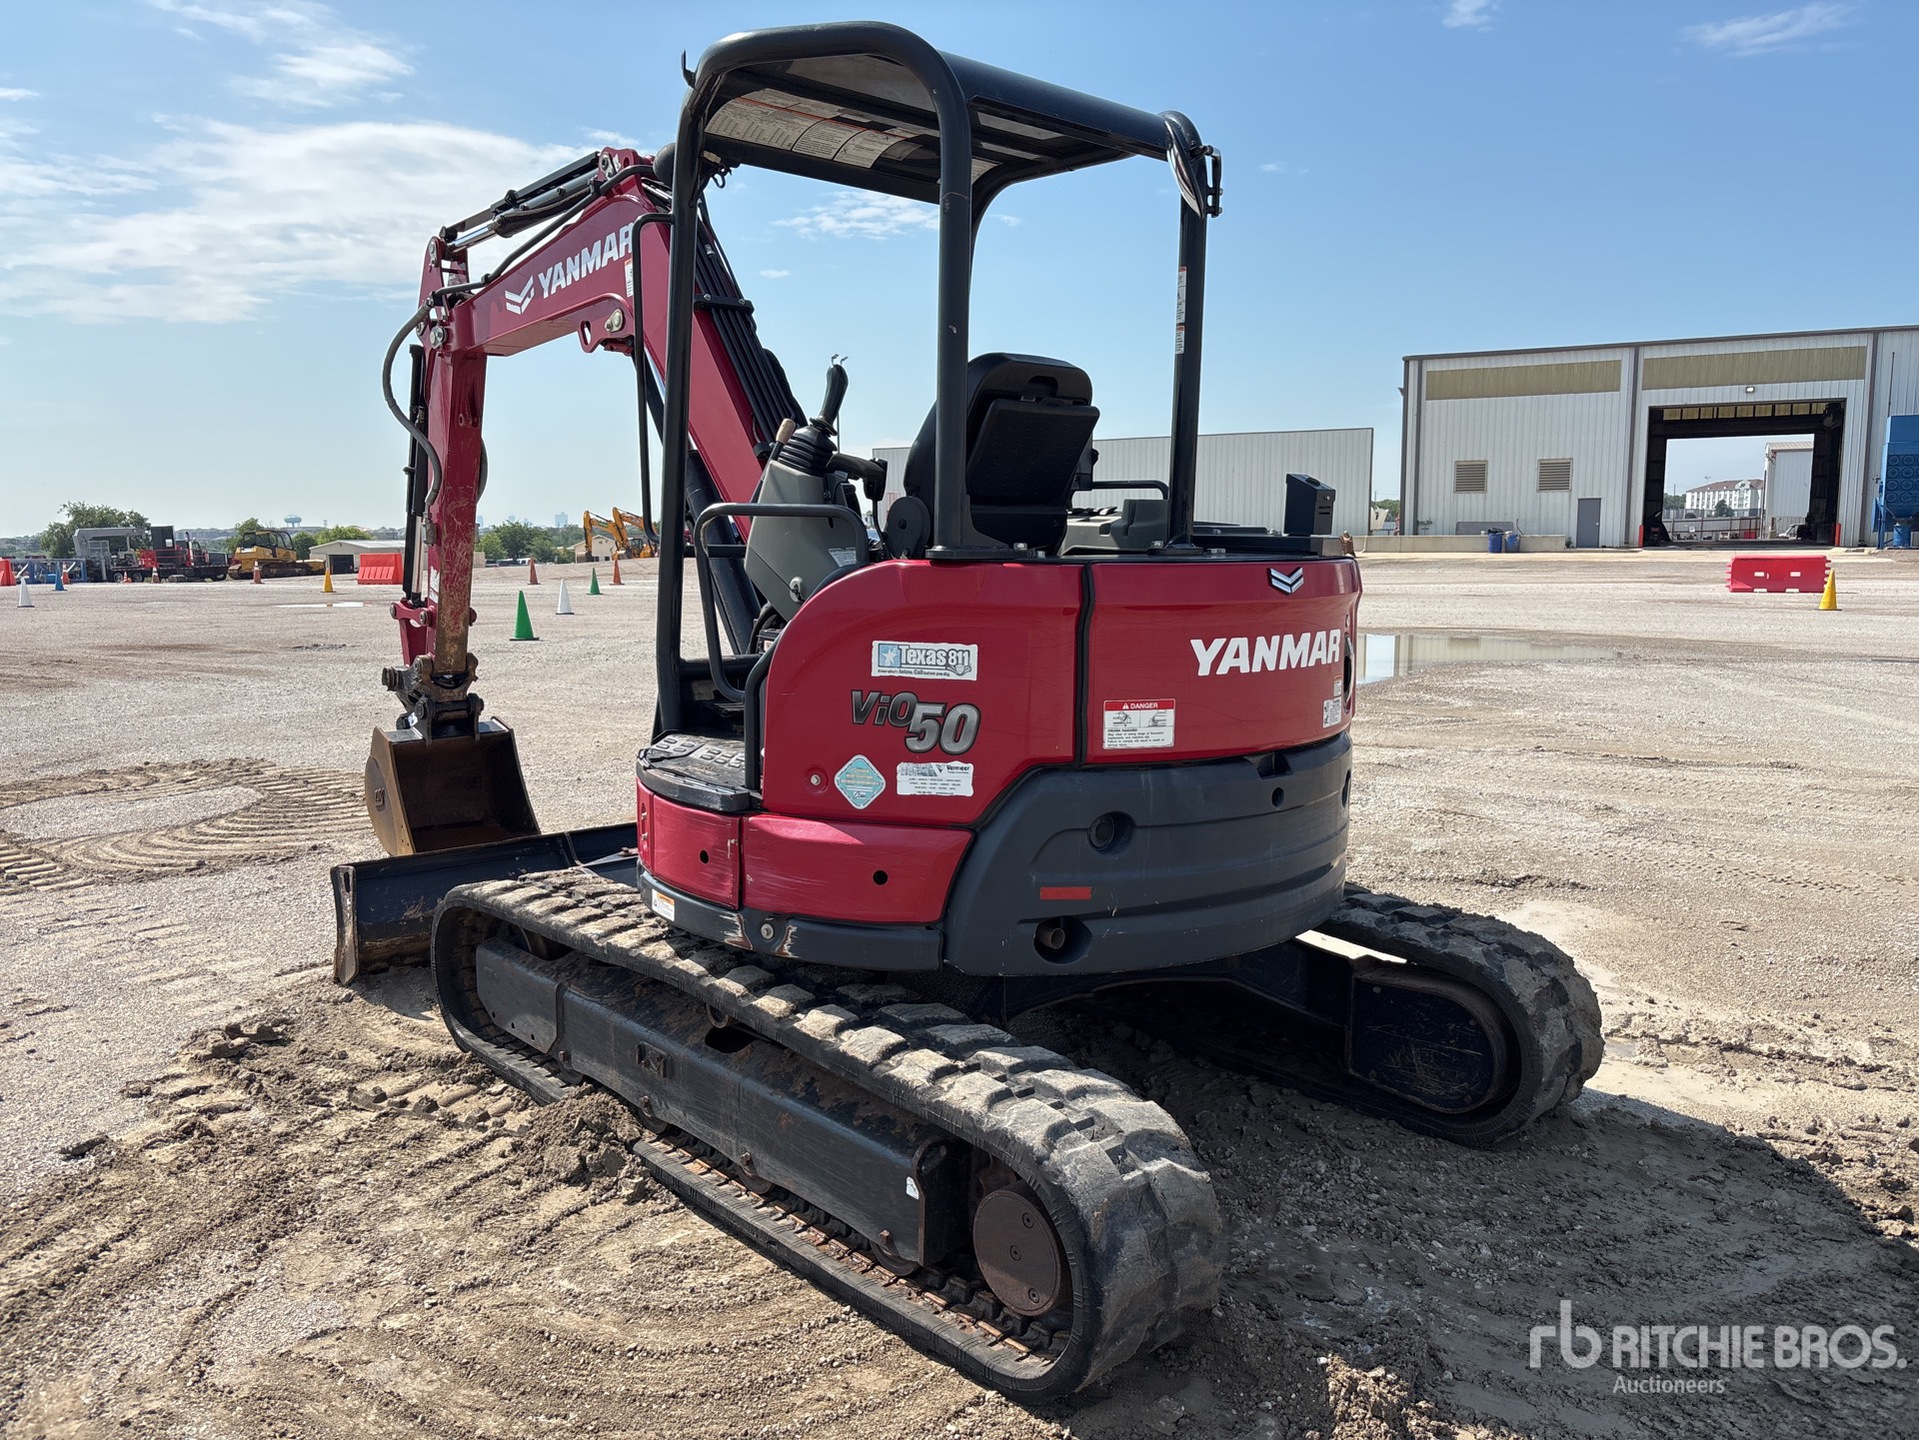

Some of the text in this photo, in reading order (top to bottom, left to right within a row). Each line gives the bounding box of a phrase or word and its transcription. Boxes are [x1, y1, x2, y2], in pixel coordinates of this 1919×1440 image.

[538, 222, 634, 299] YANMAR
[899, 645, 970, 666] Texas 811
[1190, 629, 1341, 676] YANMAR
